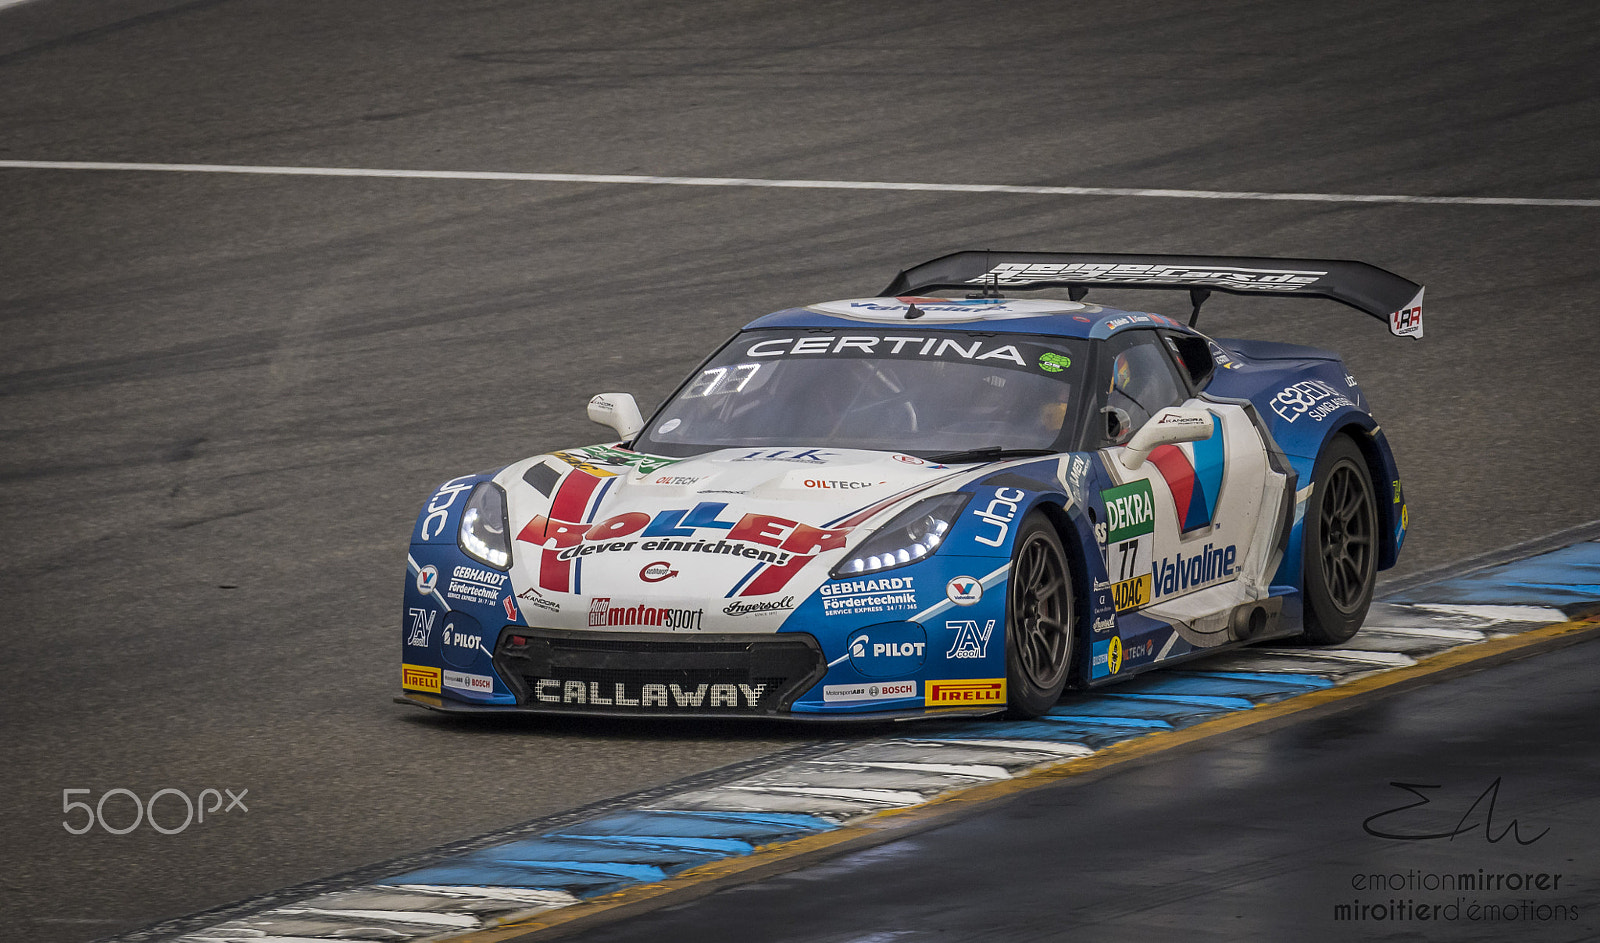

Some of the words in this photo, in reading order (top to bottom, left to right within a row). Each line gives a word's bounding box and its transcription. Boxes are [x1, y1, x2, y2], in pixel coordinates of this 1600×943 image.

[747, 337, 1027, 366] CERTINA
[655, 476, 698, 485] OILTECH
[973, 487, 1025, 548] ubc
[1105, 491, 1154, 532] DEKRA
[516, 501, 848, 554] ROLLER
[641, 538, 790, 566] einrichten!
[1118, 539, 1139, 580] 77
[453, 565, 508, 586] GEBHARDT
[1152, 543, 1237, 598] Valvoline
[448, 581, 499, 600] Fördertechnik
[820, 577, 914, 595] GEBHARDT
[1115, 578, 1143, 610] ADAC
[524, 595, 560, 608] KANDORA
[723, 596, 795, 614] Ingersoll
[823, 593, 917, 610] Fördertechnik
[854, 606, 883, 614] EXPRESS
[608, 604, 704, 631] motorsport
[453, 633, 482, 649] PILOT
[873, 642, 925, 657] PILOT
[946, 620, 996, 659] JAY
[957, 649, 979, 659] cool
[404, 668, 438, 689] PIRELLI
[472, 678, 491, 688] BOSCH
[535, 679, 768, 707] CALLAWAY
[882, 685, 913, 695] BOSCH
[932, 684, 1002, 701] PIRELLI
